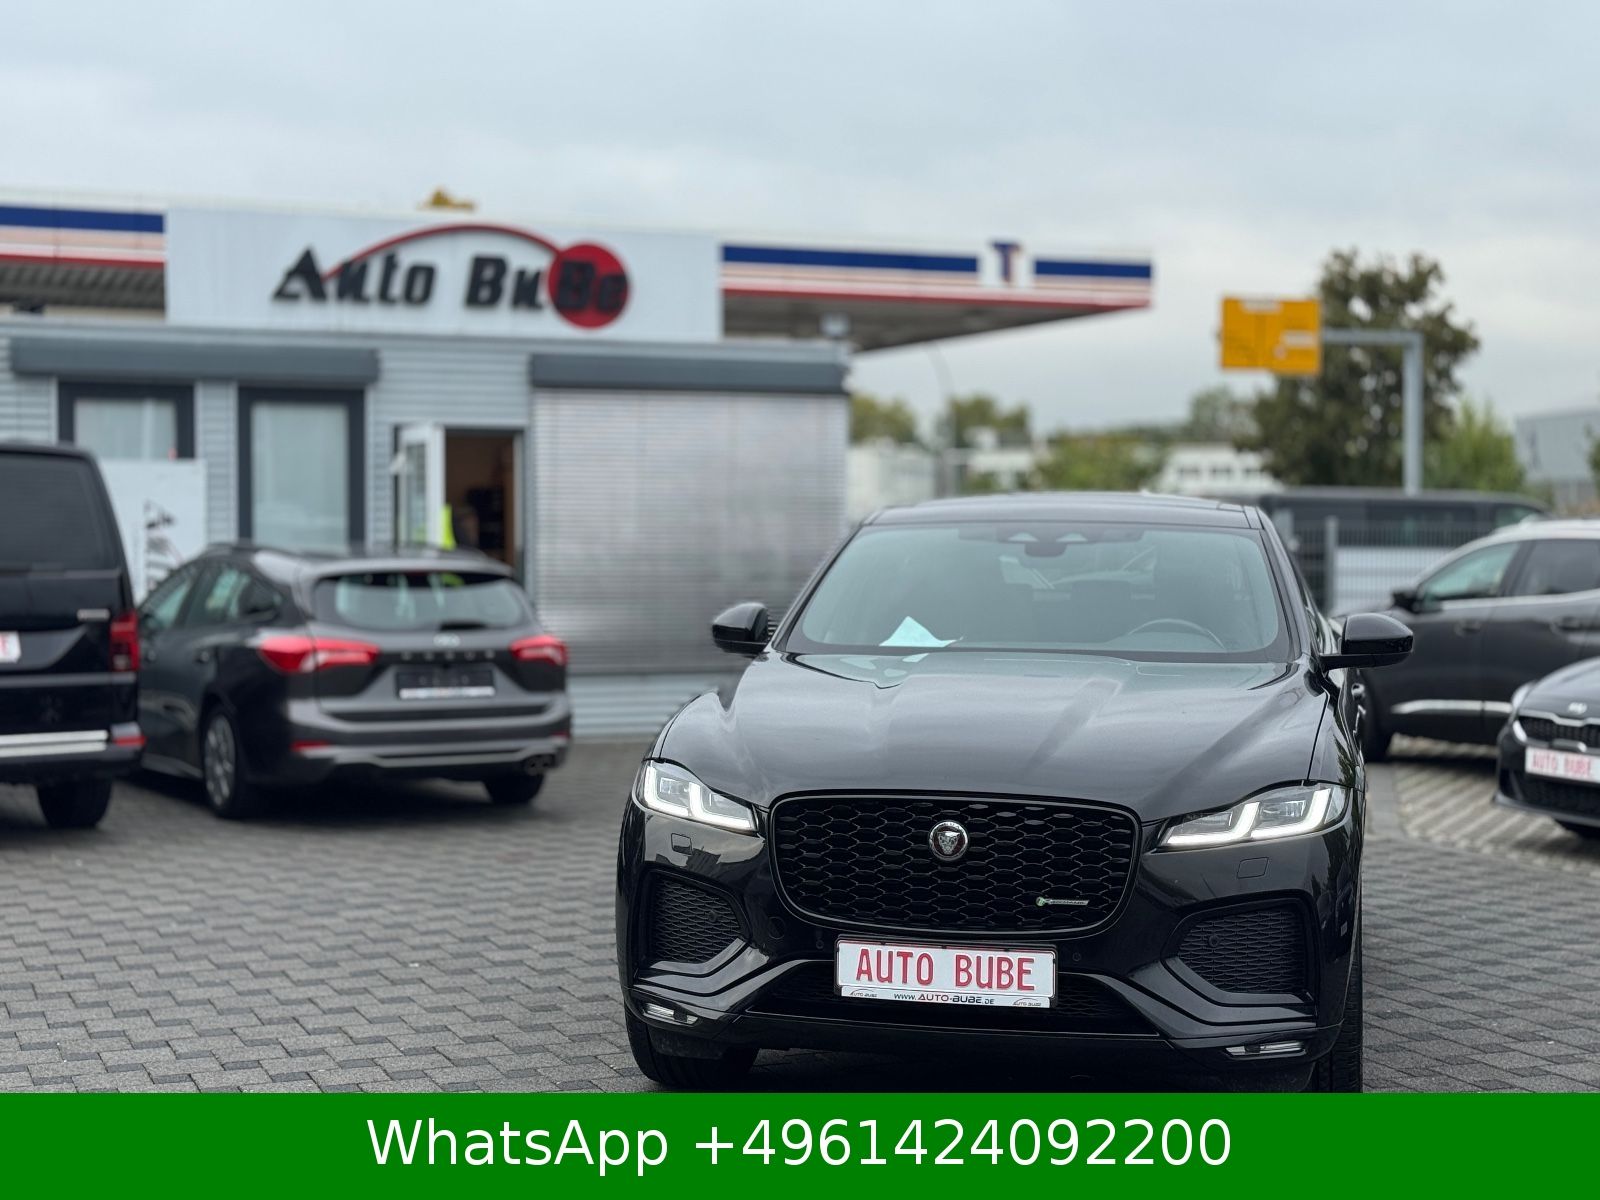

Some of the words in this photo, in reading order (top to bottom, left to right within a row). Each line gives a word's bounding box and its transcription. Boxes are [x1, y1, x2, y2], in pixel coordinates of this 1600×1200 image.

[273, 246, 435, 304] Auto
[856, 948, 934, 986] AUTO
[955, 954, 1035, 991] BUBE
